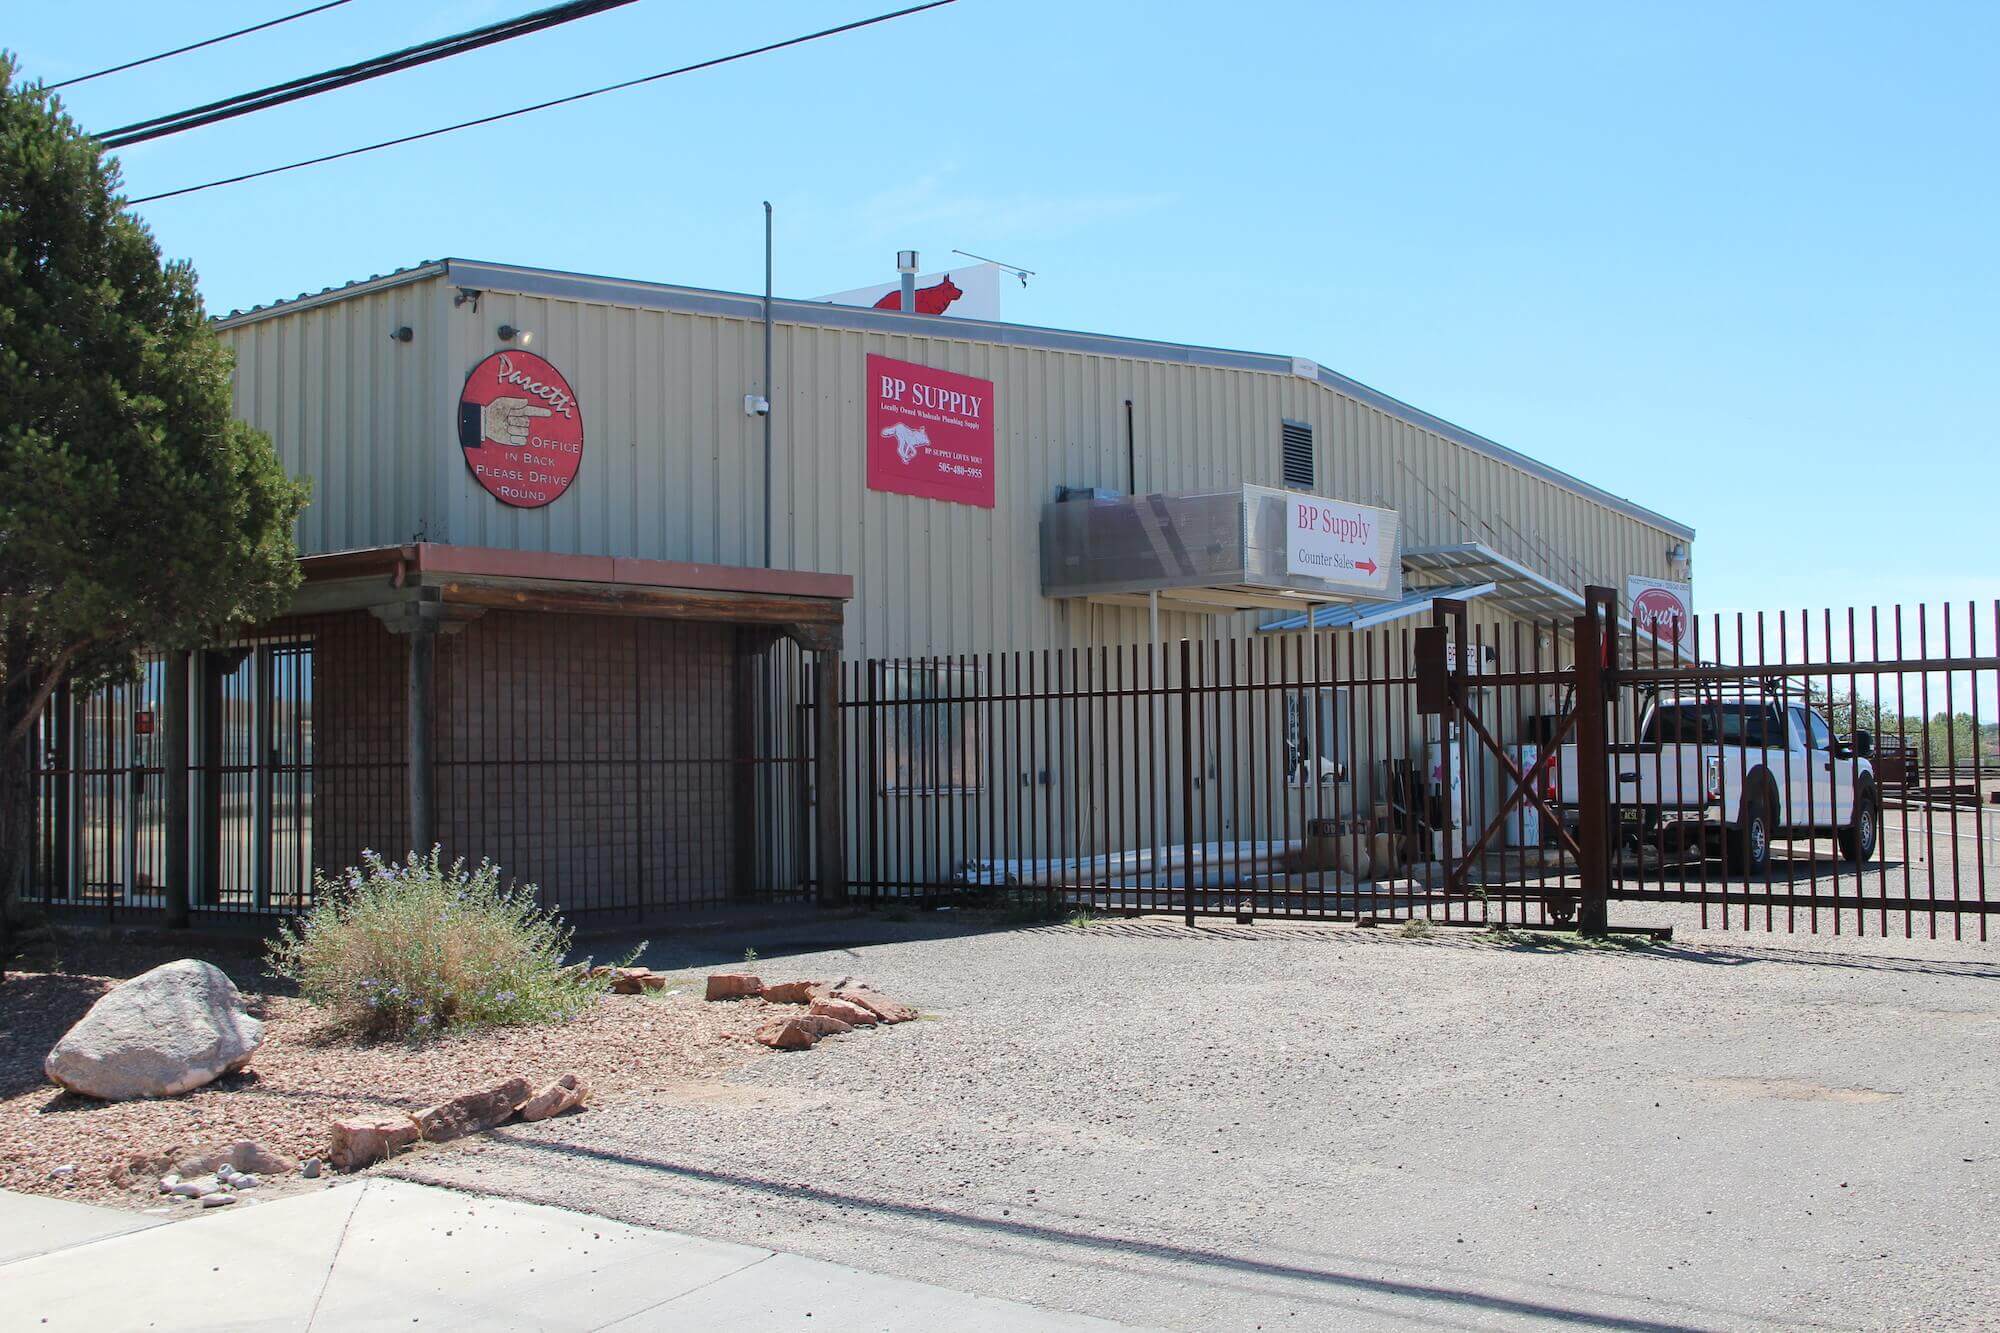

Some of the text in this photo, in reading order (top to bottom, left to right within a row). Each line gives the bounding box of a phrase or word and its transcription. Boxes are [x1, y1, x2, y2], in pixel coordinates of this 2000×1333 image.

[881, 375, 982, 418] BP SUPPLY
[881, 402, 980, 431] Locally Owned Wholesale Plumbing Supply
[531, 436, 579, 454] OFFICE
[933, 448, 952, 458] SUPPLY
[505, 452, 555, 466] IN BACK
[476, 464, 568, 487] PLEASE DRIVE
[1298, 504, 1371, 545] BP Supply
[1298, 549, 1355, 570] Counter Sales
